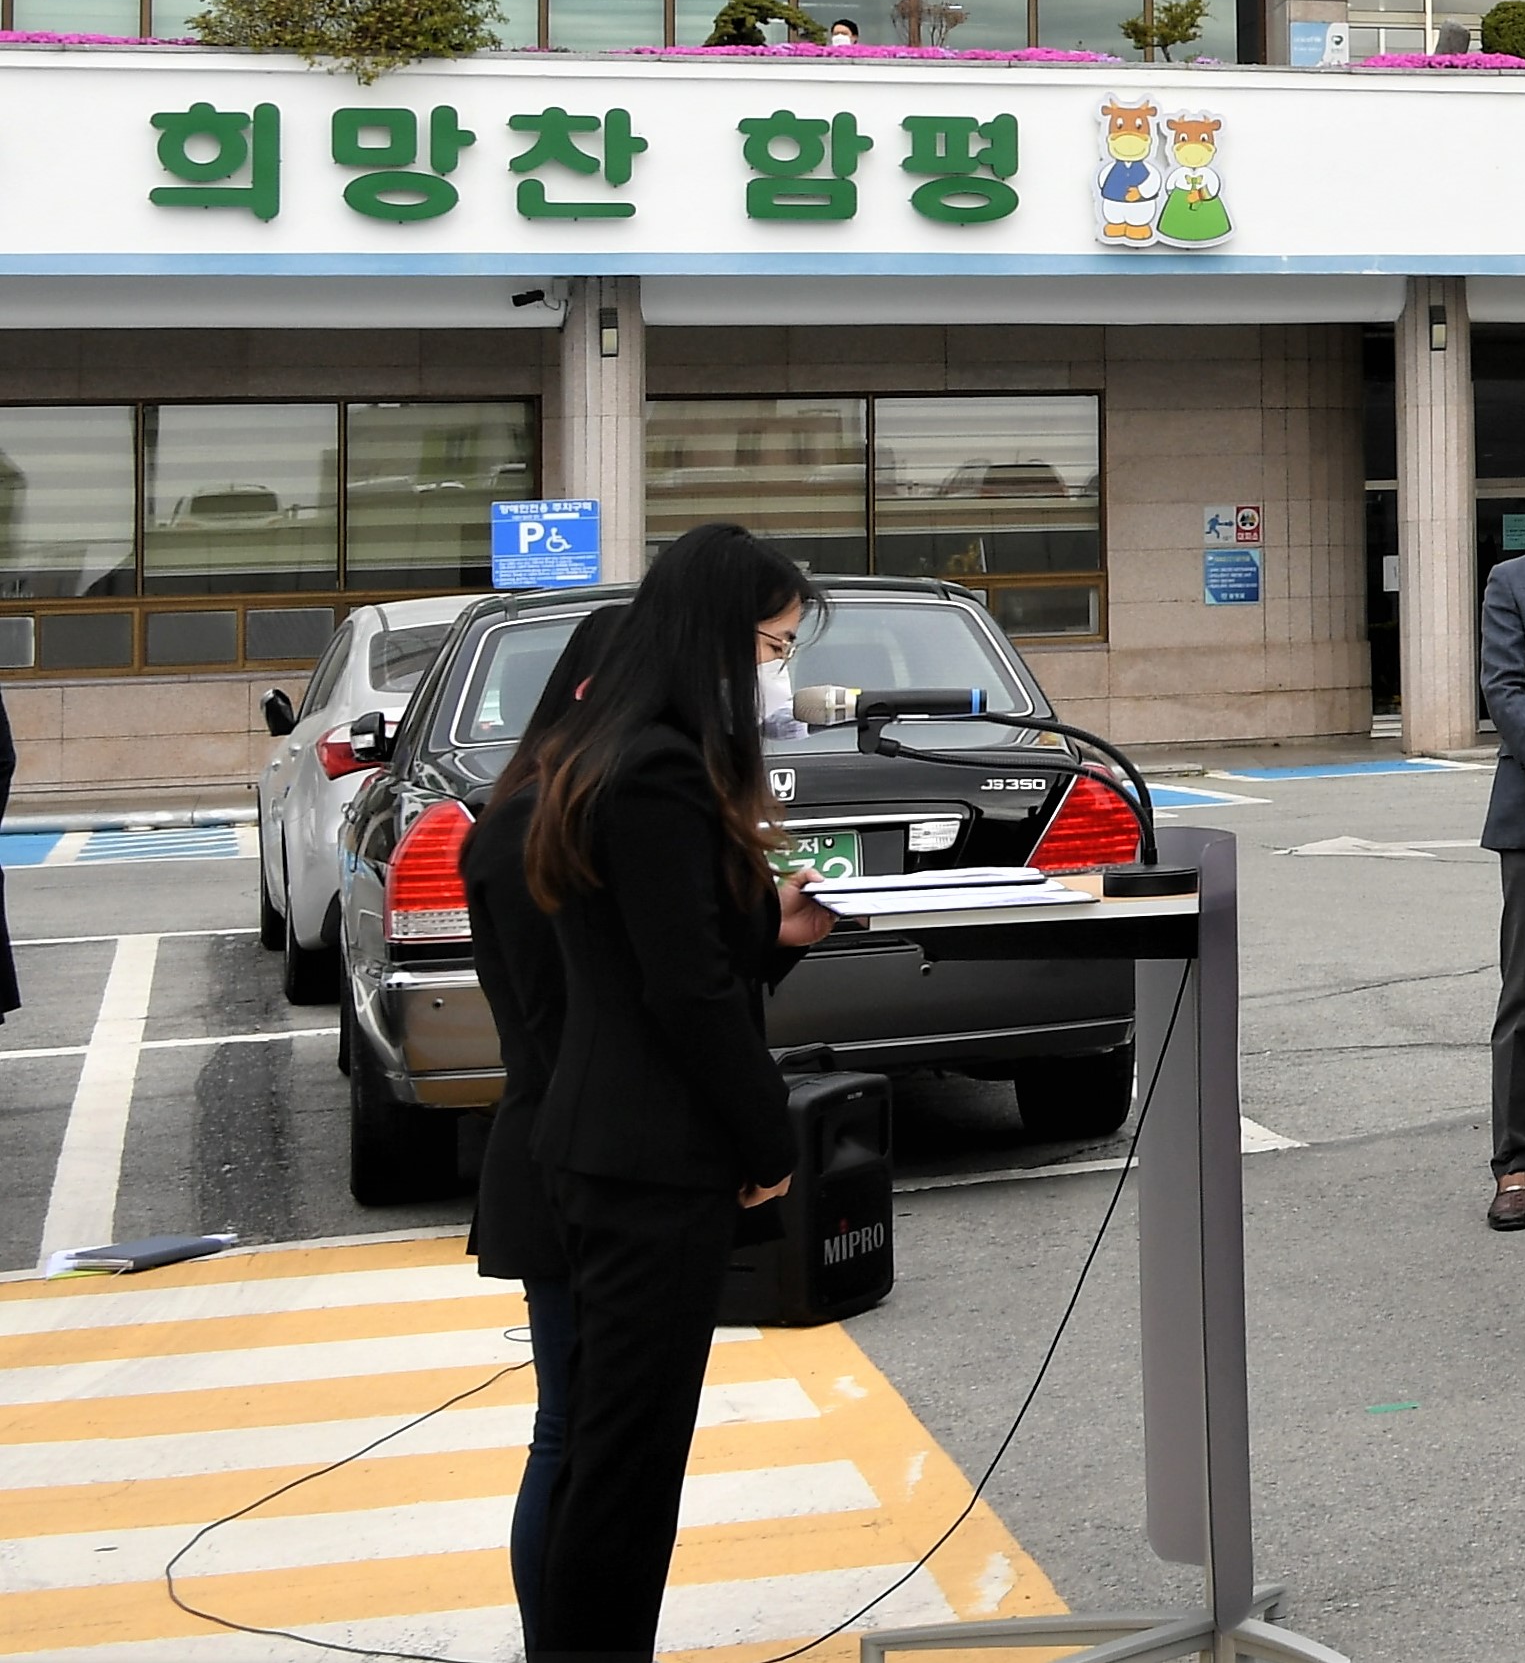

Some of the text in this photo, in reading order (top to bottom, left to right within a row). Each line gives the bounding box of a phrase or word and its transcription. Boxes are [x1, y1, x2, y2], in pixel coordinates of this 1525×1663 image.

[149, 101, 1019, 225] 희망찬 함평
[824, 1222, 884, 1266] MIPRO
